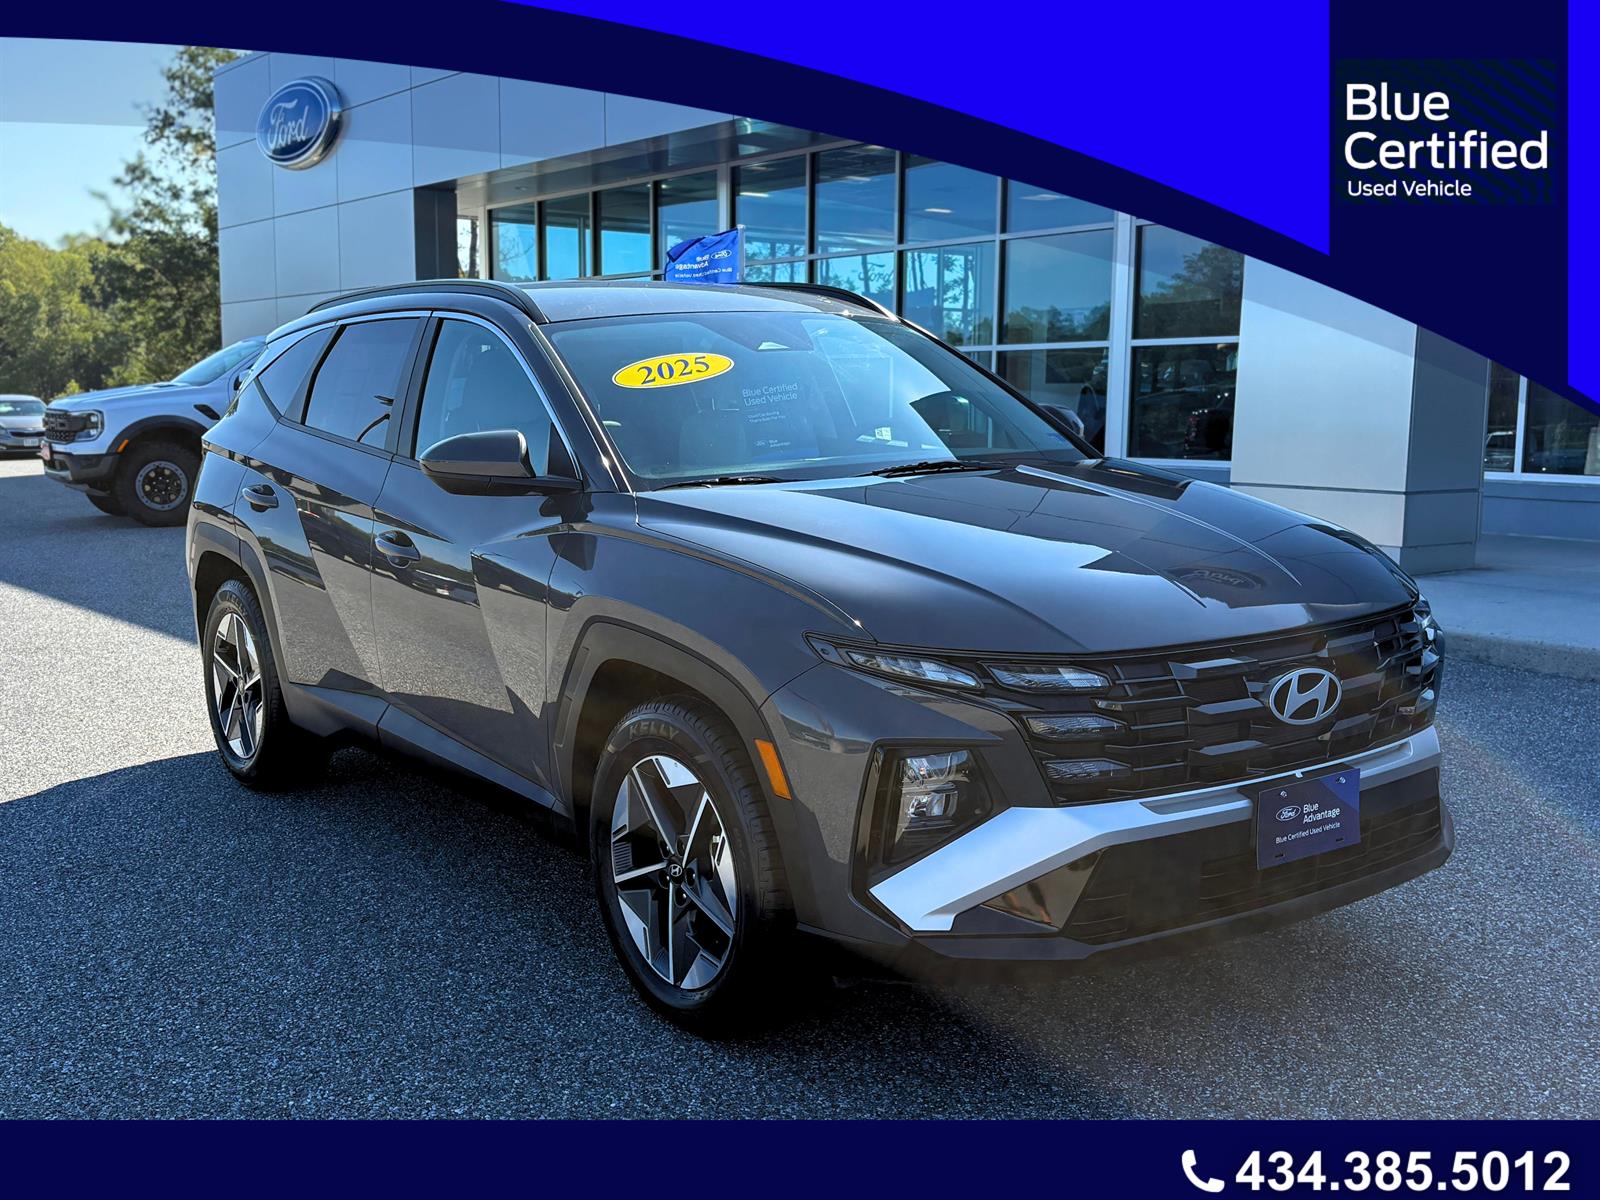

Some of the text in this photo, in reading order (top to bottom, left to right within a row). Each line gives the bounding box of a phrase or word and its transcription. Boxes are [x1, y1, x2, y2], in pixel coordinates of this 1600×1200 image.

[268, 98, 309, 149] Ford
[637, 356, 710, 384] 2025
[742, 383, 798, 397] Blue Certified
[743, 393, 798, 407] Used Vehicle
[628, 720, 680, 741] KELLY
[1302, 807, 1340, 824] Advantage
[1303, 802, 1319, 814] Blue
[1275, 822, 1340, 844] Blue Certified Used Vehicle
